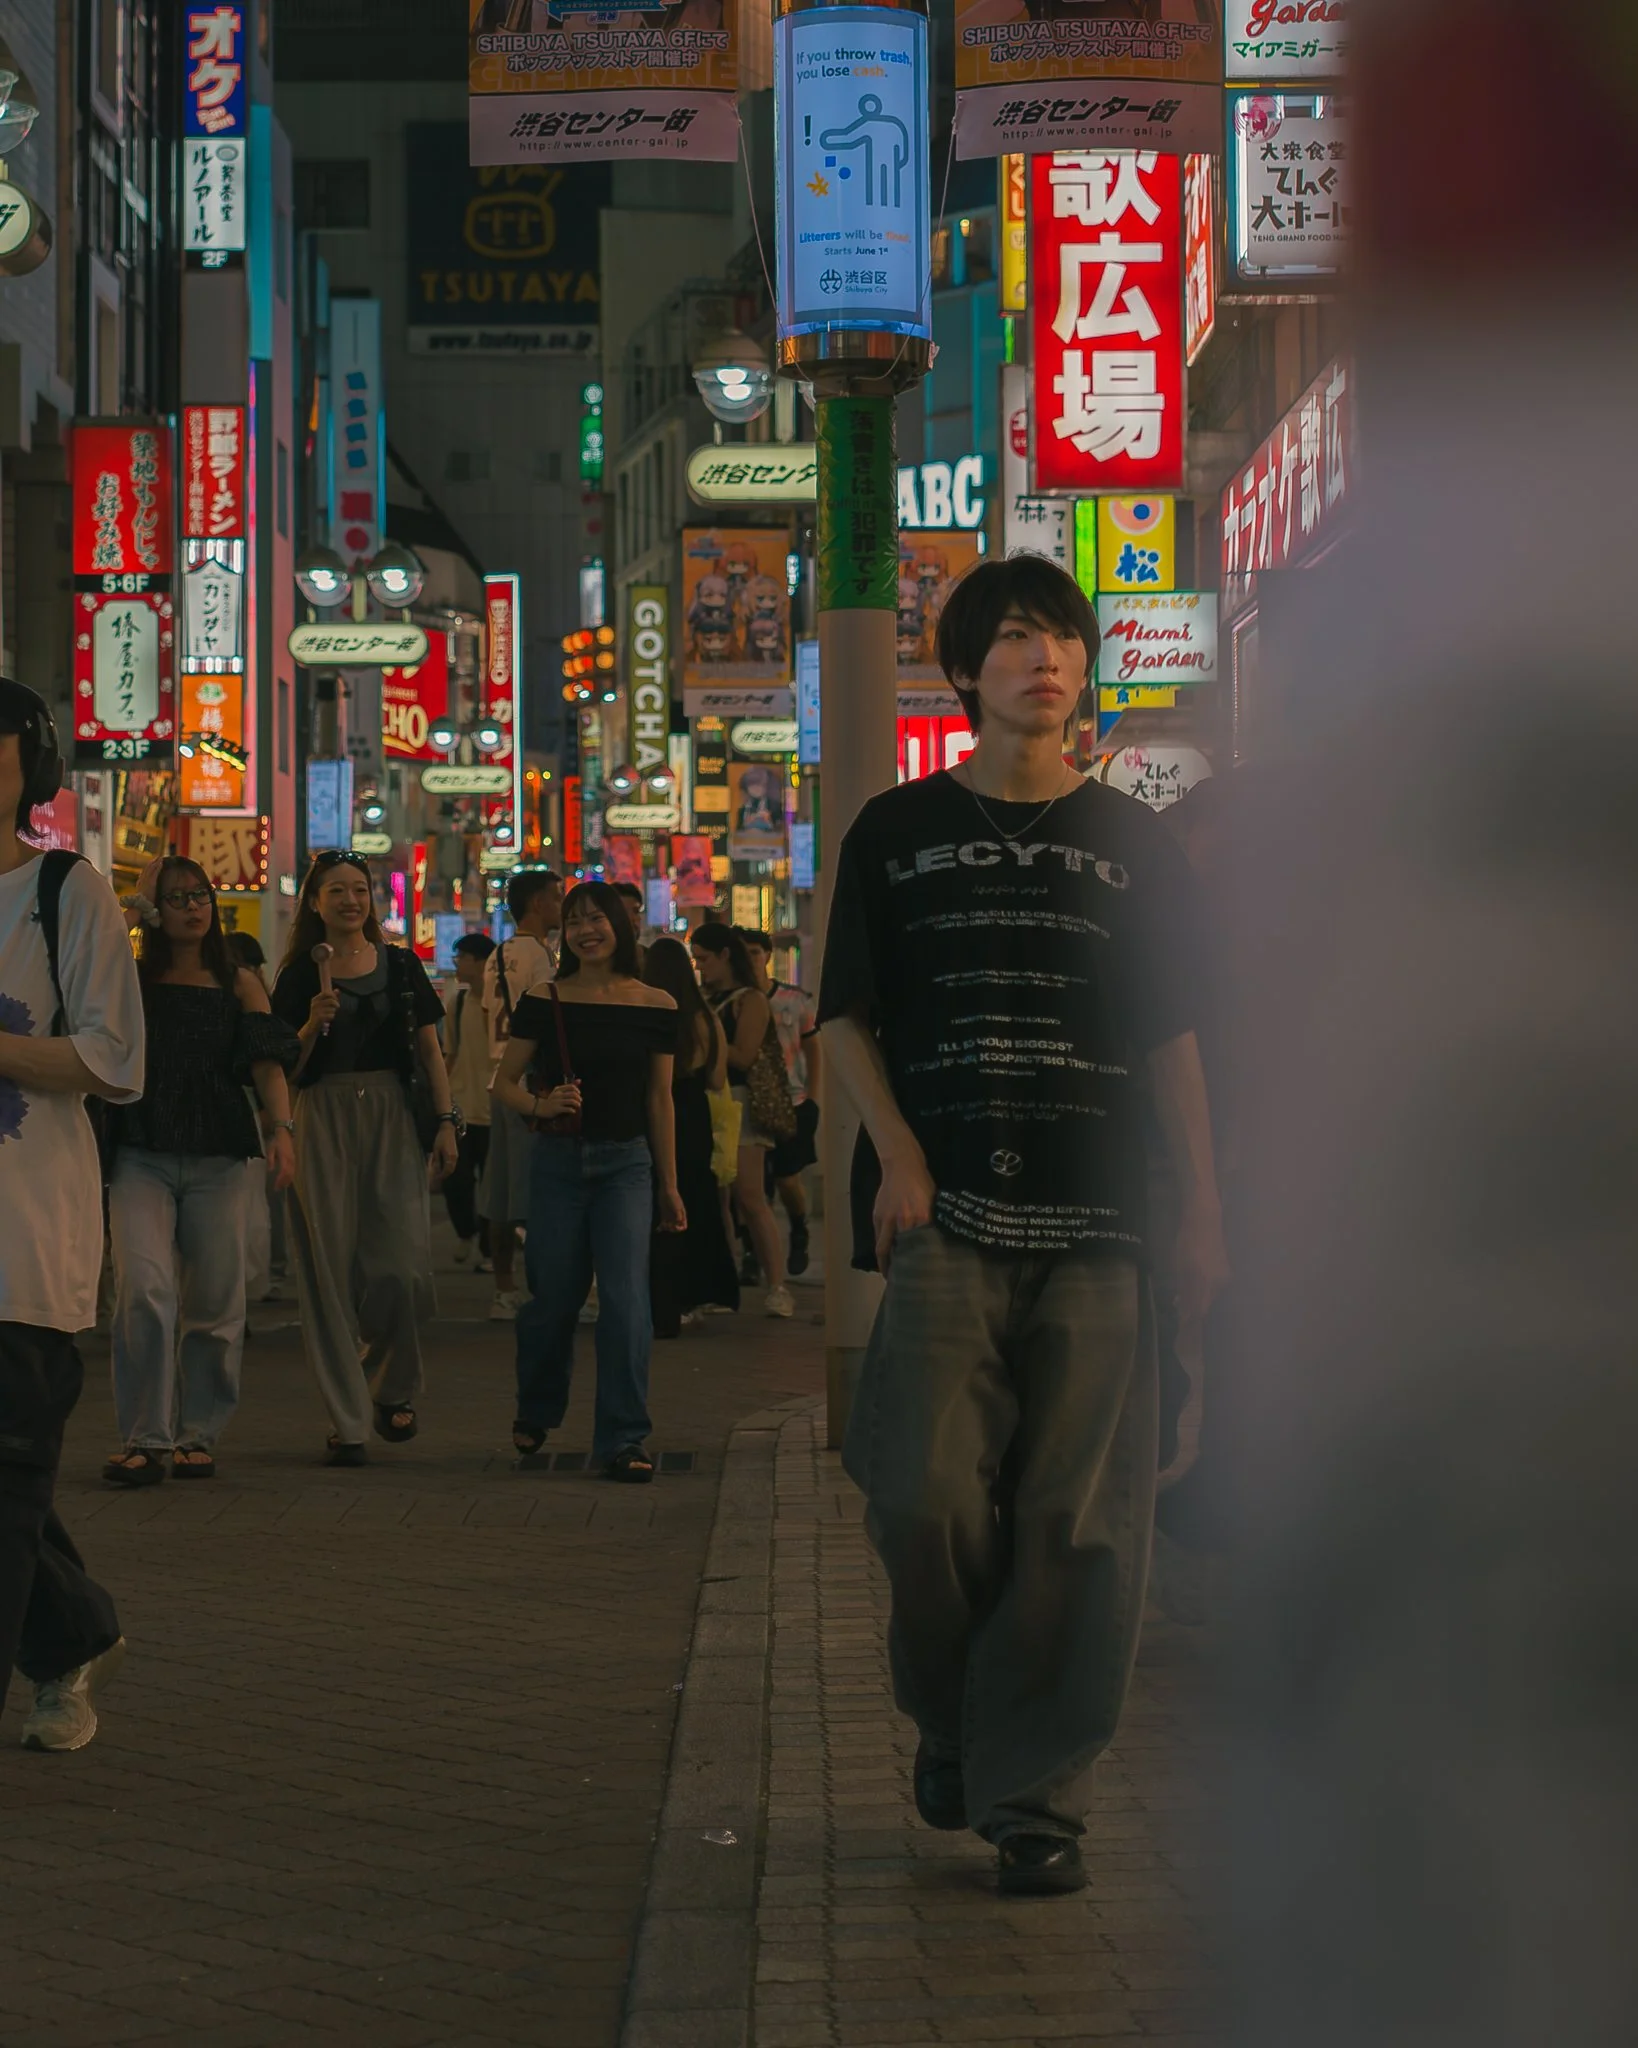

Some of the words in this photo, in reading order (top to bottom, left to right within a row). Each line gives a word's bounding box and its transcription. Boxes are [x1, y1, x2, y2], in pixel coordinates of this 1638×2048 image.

[1245, 0, 1345, 38] garde
[478, 33, 568, 53] SHIBUYA
[573, 30, 669, 49] TSUTAYA
[672, 30, 729, 48] 6Fにて
[963, 22, 1051, 46] SHIBUYA
[1055, 20, 1152, 39] TSUTAYA
[1153, 22, 1213, 42] 6Fにて
[188, 7, 241, 108] オケ
[507, 50, 700, 73] ポップアップストア開催中
[796, 51, 806, 66] If
[808, 51, 831, 69] you
[834, 48, 876, 60] throw
[880, 49, 912, 68] trash,
[990, 40, 1184, 63] ポップアップストア開催中
[797, 69, 818, 83] you
[822, 65, 850, 77] lose
[853, 65, 888, 78] cash.
[510, 107, 700, 138] 渋谷センター街
[993, 96, 1184, 127] 渋谷センター街
[519, 137, 689, 152] http://www.center-gai.jp
[1002, 127, 1174, 141] http://www.center-gai.jp
[1260, 140, 1348, 161] 大衆食堂
[1266, 166, 1338, 196] てんぐ
[193, 147, 214, 243] ルノアール
[800, 229, 841, 244] Litterers
[845, 230, 867, 240] will
[869, 229, 883, 240] be
[1307, 235, 1332, 243] FOOD
[202, 251, 228, 267] 2F
[824, 247, 852, 255] Starts
[855, 246, 876, 256] June
[421, 269, 599, 304] TSUTAYA
[844, 271, 888, 285] 渋谷区
[844, 286, 873, 294] Shibuya
[875, 286, 888, 294] City
[1049, 150, 1166, 462] 歌広場
[130, 430, 161, 571] 築地もんじゃ
[897, 454, 985, 528] ABC
[91, 469, 124, 571] お好み焼
[1115, 543, 1160, 583] 松
[1103, 619, 1193, 642] Miami
[1118, 648, 1214, 681] garden
[634, 600, 664, 770] GOTCHA
[1140, 764, 1181, 780] てんぐ
